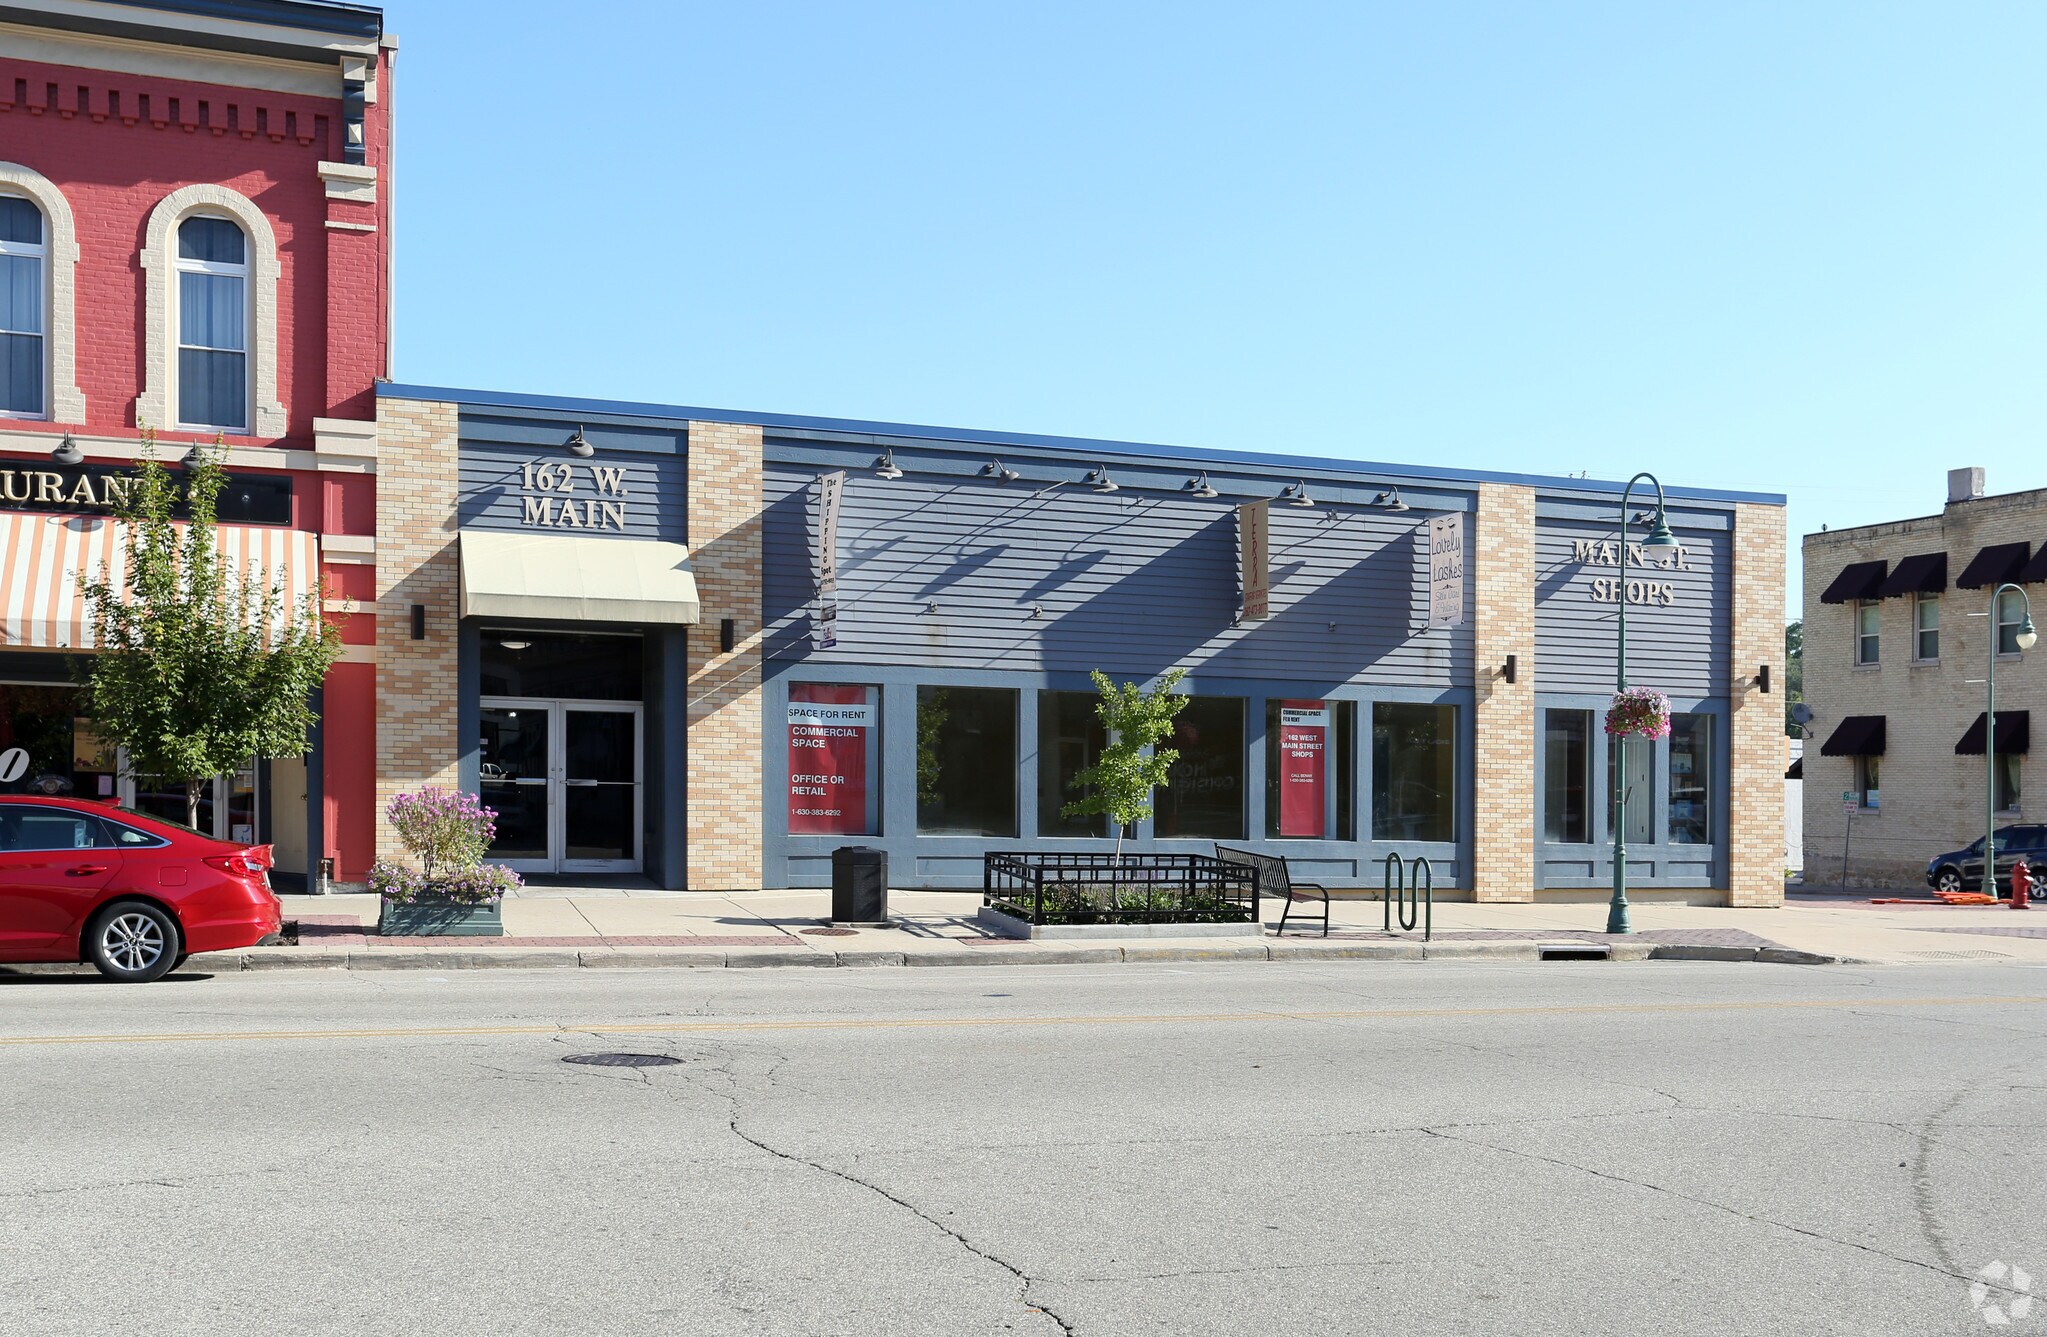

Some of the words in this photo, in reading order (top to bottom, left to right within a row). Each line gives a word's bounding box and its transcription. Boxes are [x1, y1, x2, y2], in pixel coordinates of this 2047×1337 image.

[522, 461, 575, 493] 162
[590, 466, 628, 496] W.
[826, 478, 837, 488] The
[0, 469, 148, 506] URAN
[522, 496, 627, 530] MAIN
[1431, 531, 1461, 558] Lovely
[1573, 540, 1645, 567] MAIN
[1433, 558, 1463, 582] Lashes
[1592, 578, 1674, 606] SHOPS
[788, 708, 818, 718] SPACE
[820, 710, 839, 719] FOR
[841, 711, 866, 719] RENT
[792, 726, 859, 737] COMMERCIAL
[792, 738, 826, 748] SPACE
[1291, 750, 1314, 758] SHOPS
[791, 774, 828, 784] OFFICE
[830, 775, 845, 785] OR
[791, 786, 827, 796] RETAIL
[791, 808, 841, 816] 1-630-383-6292
